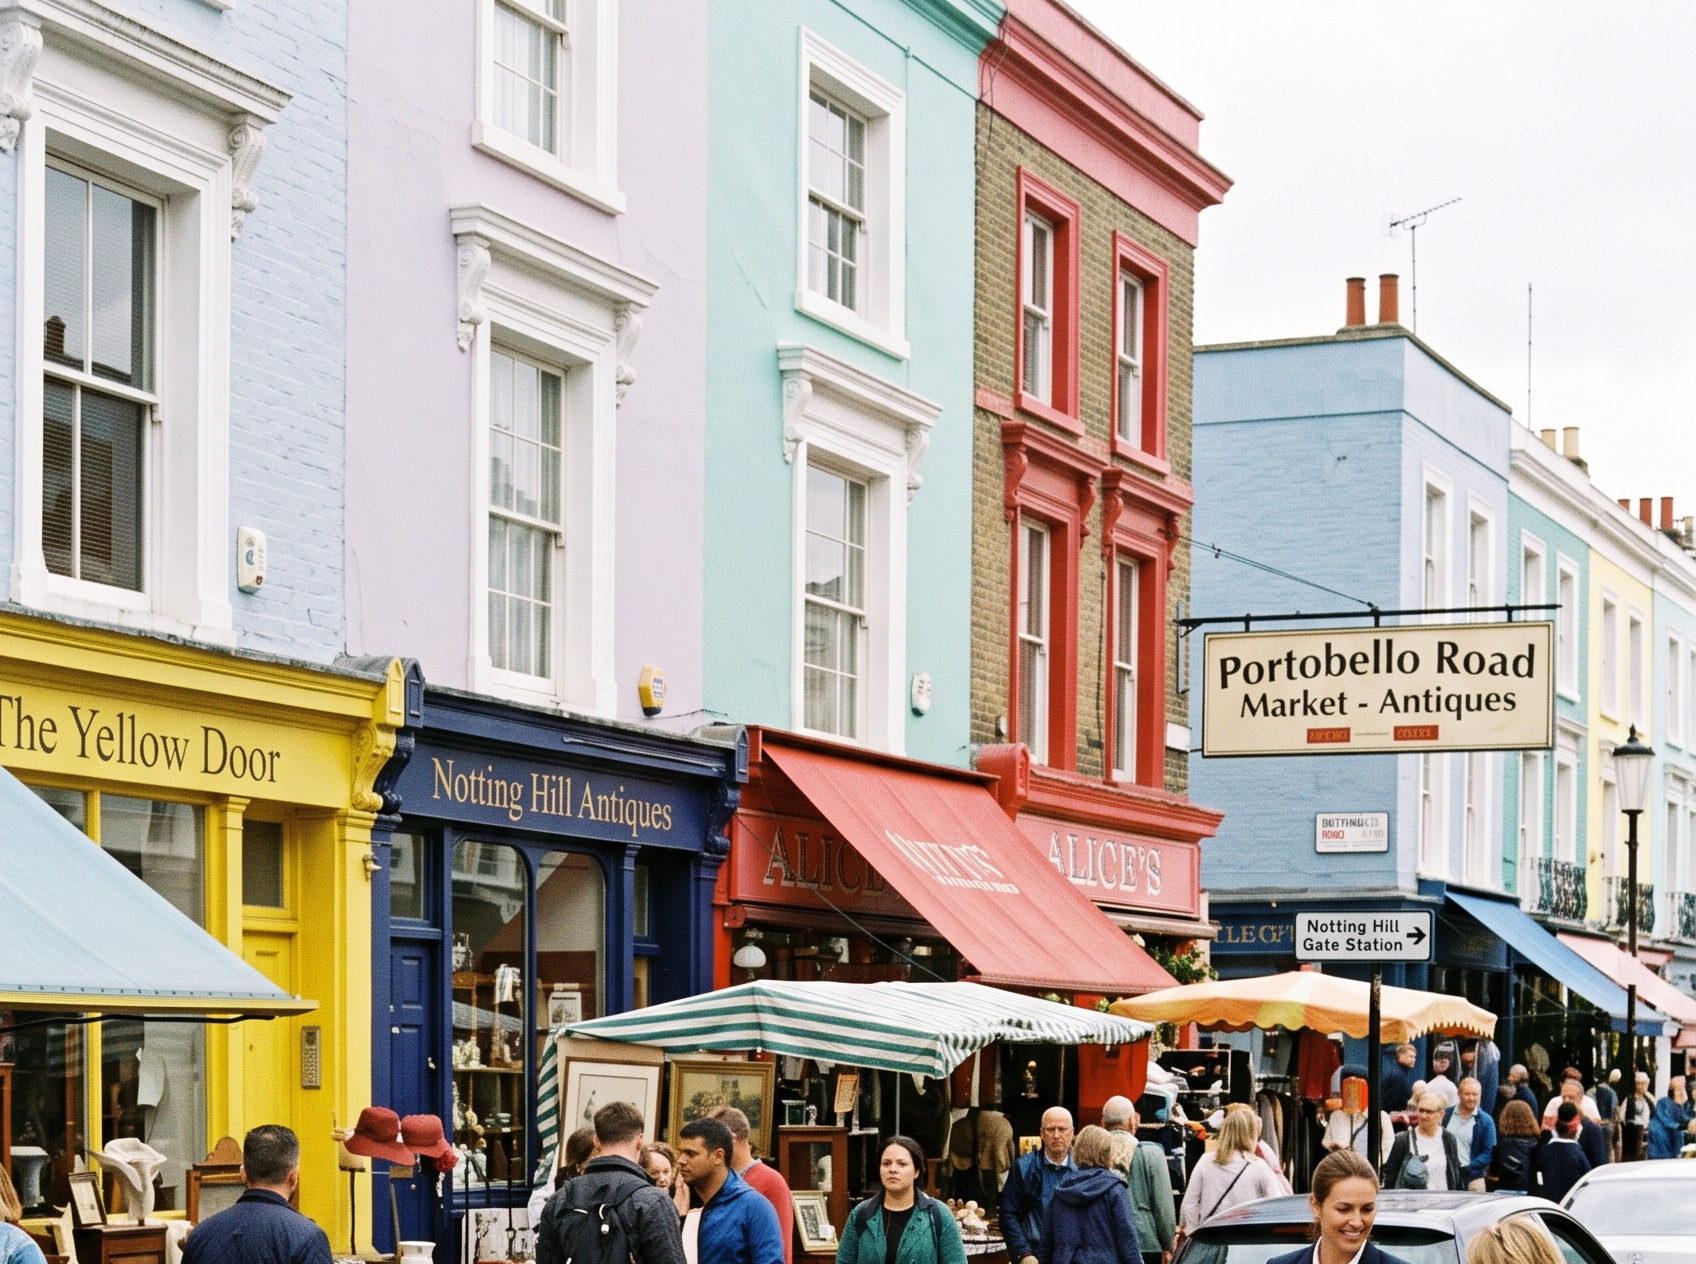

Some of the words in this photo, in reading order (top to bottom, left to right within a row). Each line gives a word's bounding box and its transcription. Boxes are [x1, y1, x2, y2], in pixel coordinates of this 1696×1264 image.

[1219, 638, 1420, 689] Portobello
[1437, 641, 1535, 679] Road
[1240, 689, 1348, 718] Market
[1379, 686, 1517, 720] Antiques
[67, 705, 190, 772] Yellow
[200, 725, 281, 783] Door
[431, 757, 523, 822] Notting
[530, 772, 573, 817] Hill
[577, 781, 673, 838] Antiques
[1048, 831, 1162, 896] ALICE'S
[1303, 938, 1339, 951] Gate
[1345, 938, 1403, 951] Station
[1307, 919, 1366, 935] Notting
[1373, 919, 1400, 933] Hill
